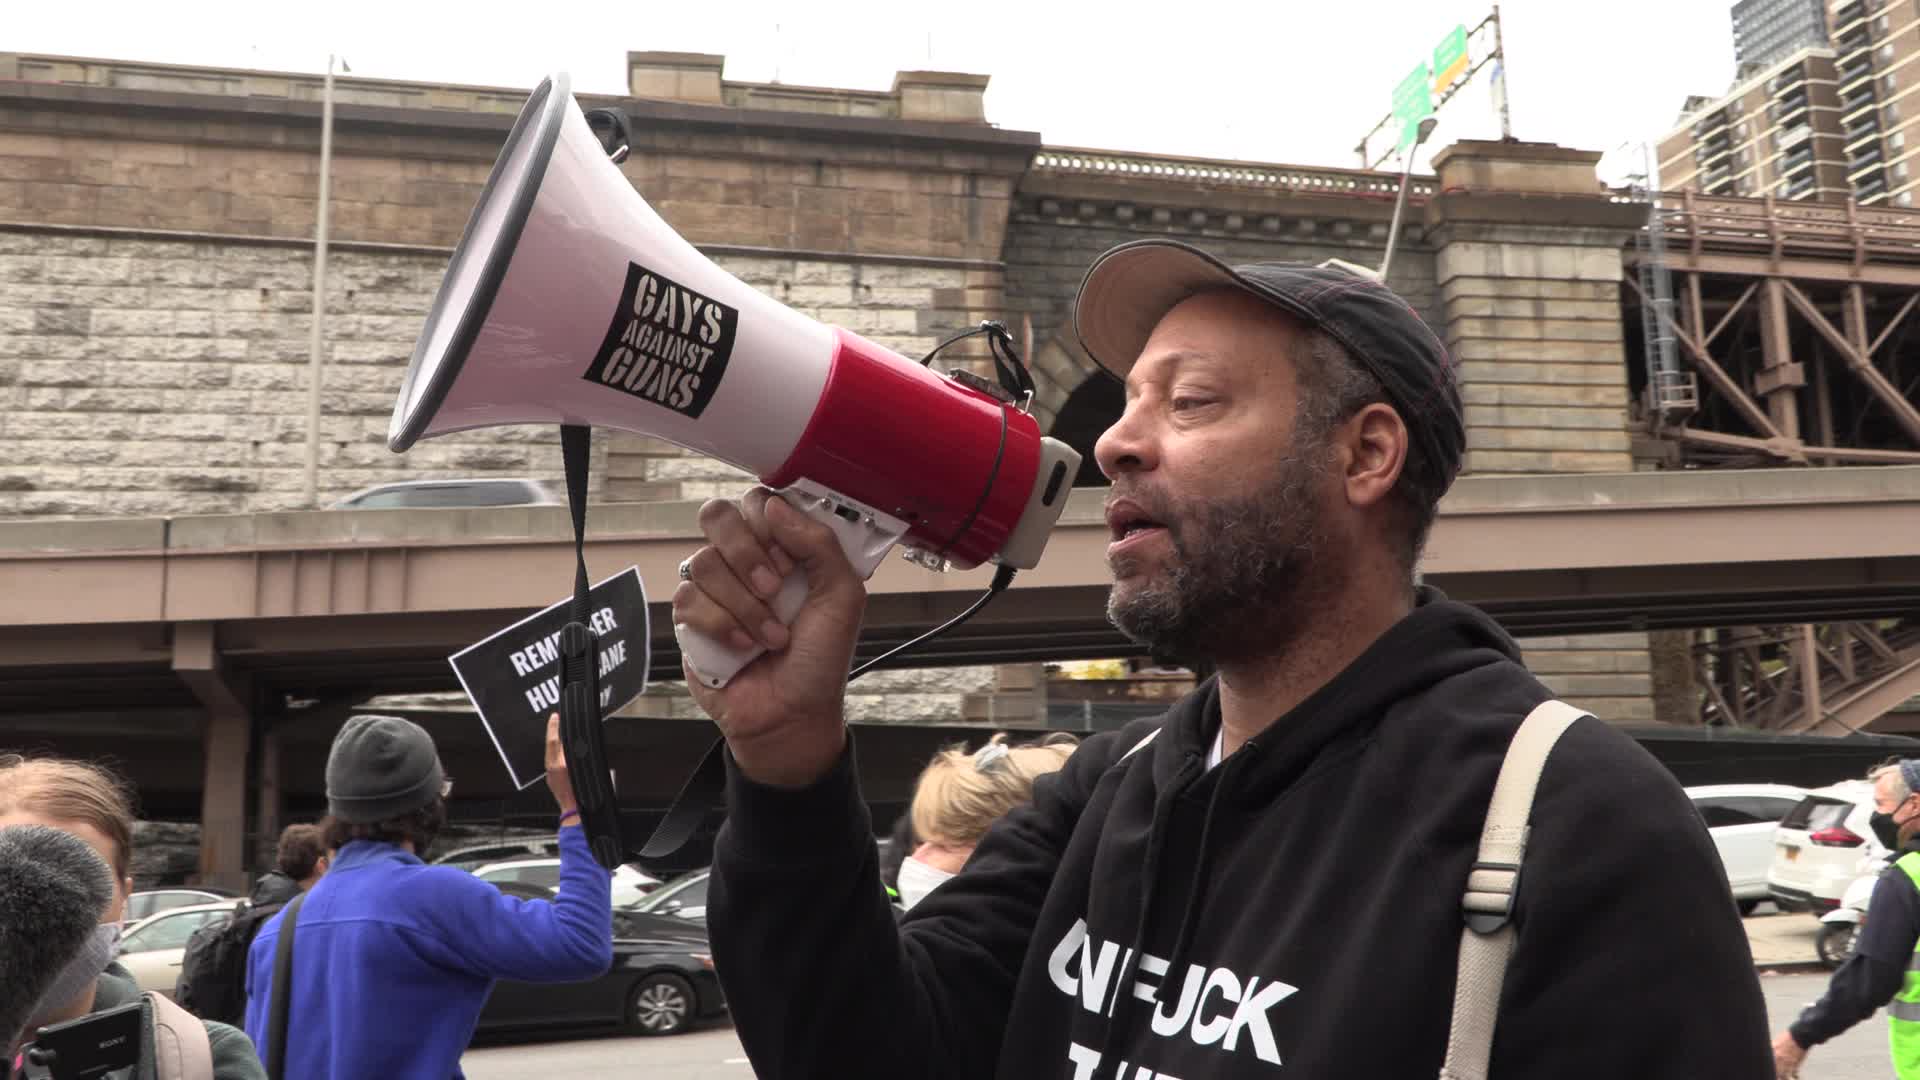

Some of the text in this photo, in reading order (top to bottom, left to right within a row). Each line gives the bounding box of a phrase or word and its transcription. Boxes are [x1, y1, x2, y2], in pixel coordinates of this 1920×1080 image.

[633, 273, 722, 344] GAYS
[601, 347, 700, 409] GUNS
[620, 319, 714, 373] AGAINST
[509, 607, 617, 677] REMER
[525, 640, 627, 713] HUANE
